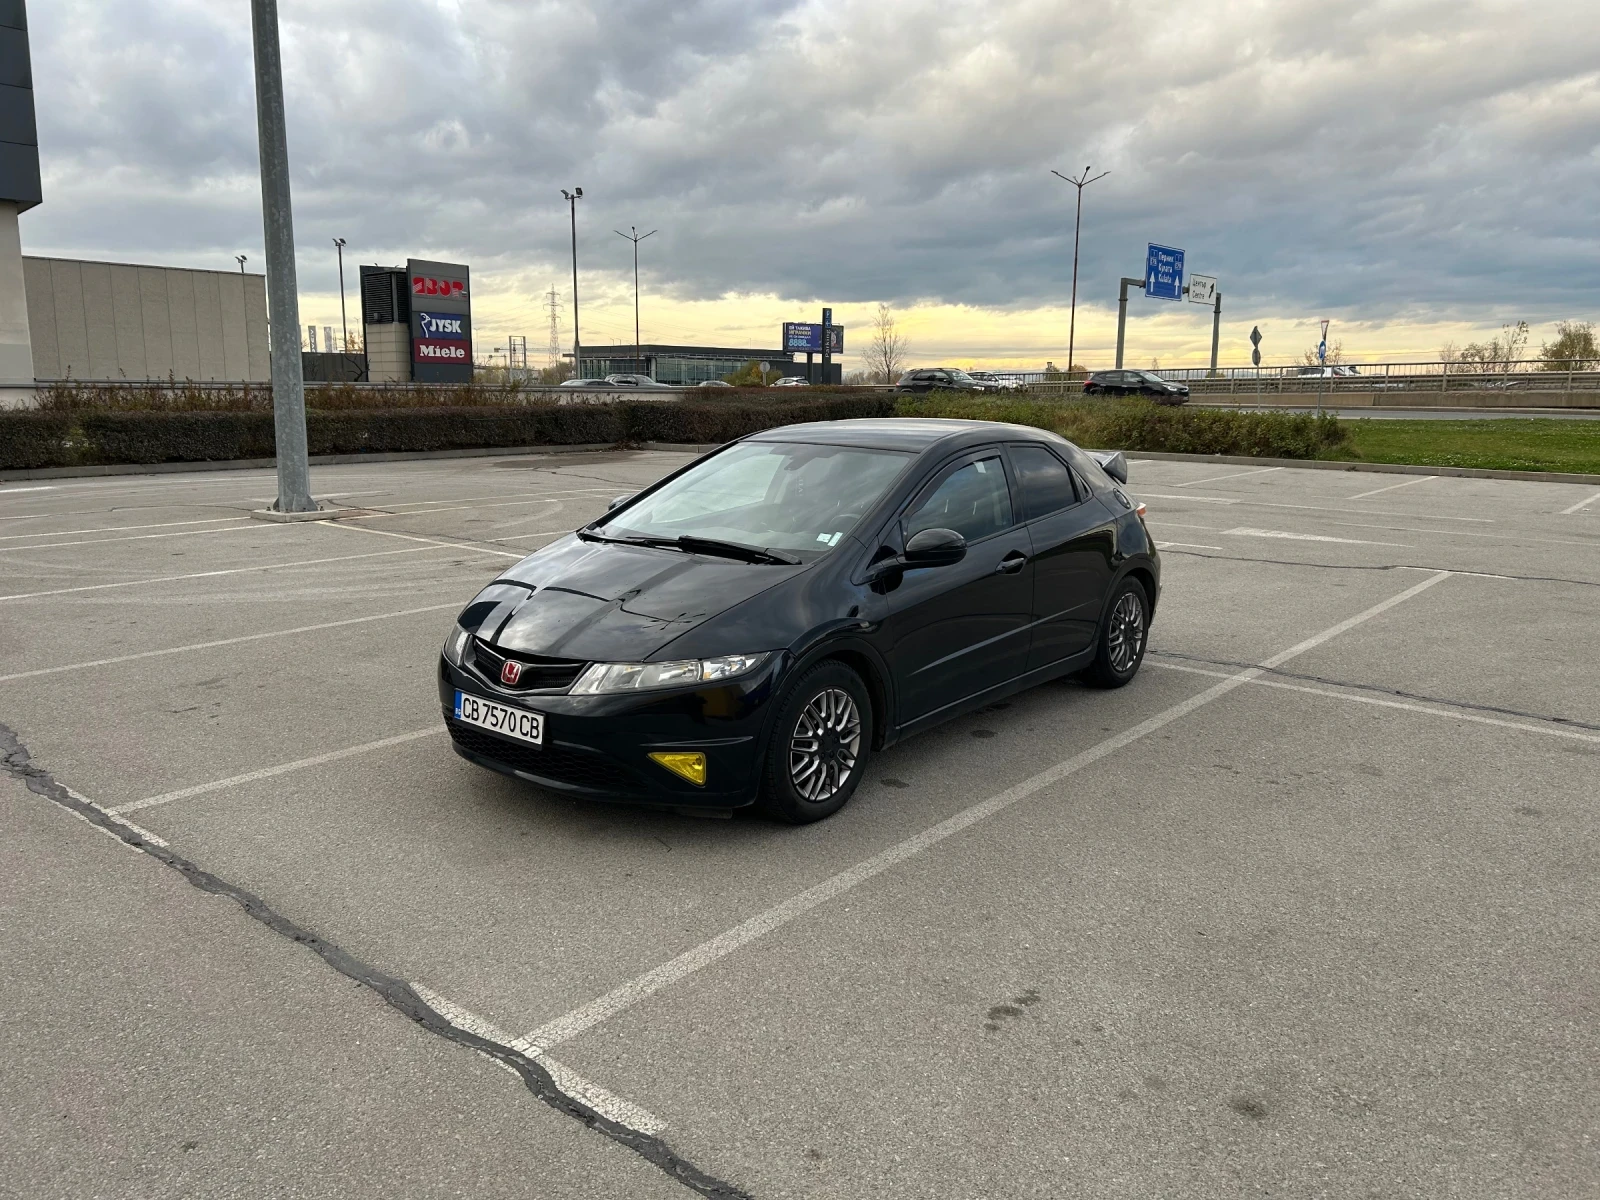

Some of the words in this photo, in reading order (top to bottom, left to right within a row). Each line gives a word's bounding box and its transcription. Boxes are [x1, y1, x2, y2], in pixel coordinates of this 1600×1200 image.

[429, 319, 462, 333] JYSK
[419, 345, 465, 358] Miele
[463, 698, 480, 721] CB
[482, 703, 516, 732] 7570
[520, 715, 540, 739] CB
